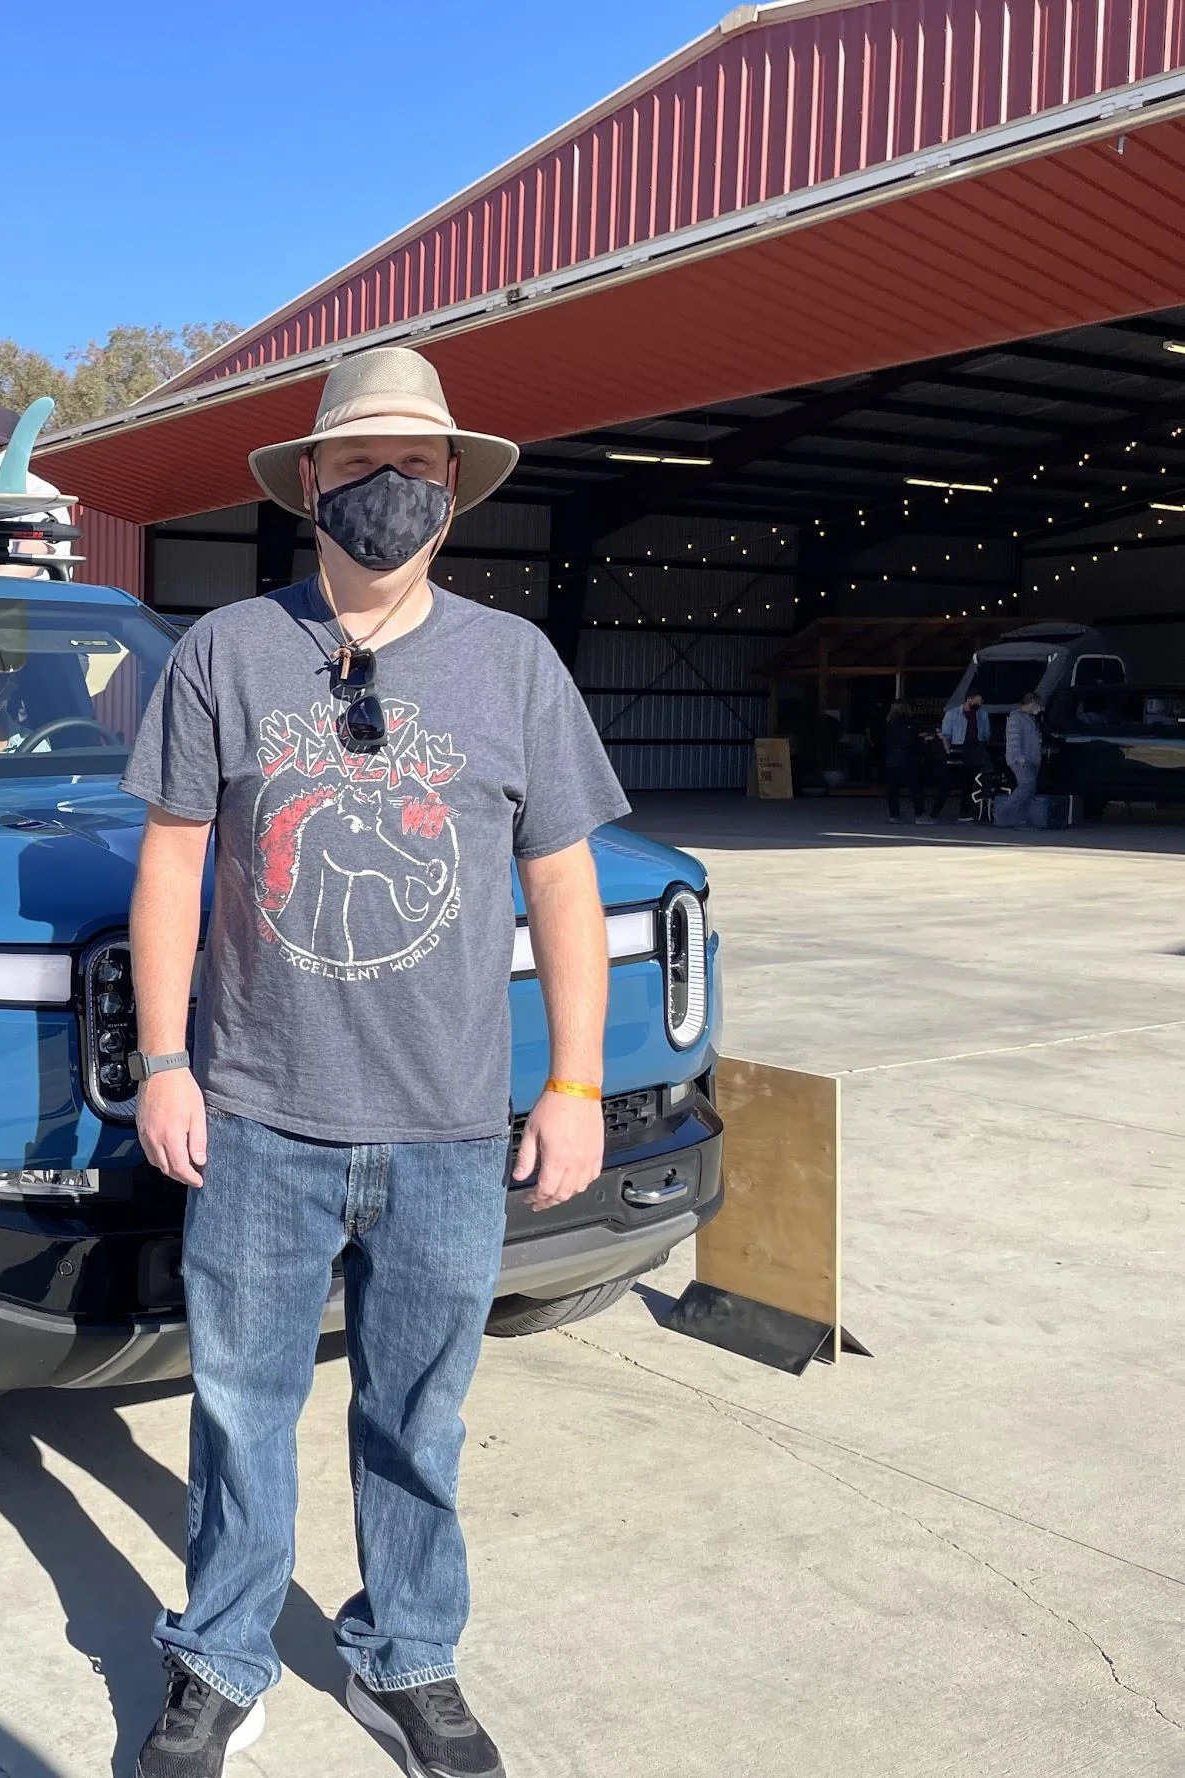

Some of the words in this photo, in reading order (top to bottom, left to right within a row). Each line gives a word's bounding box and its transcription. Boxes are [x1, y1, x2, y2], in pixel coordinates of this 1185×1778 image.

[278, 943, 381, 981] EXCELLENT
[389, 933, 440, 973] WORLD
[439, 886, 462, 928] TOUR
